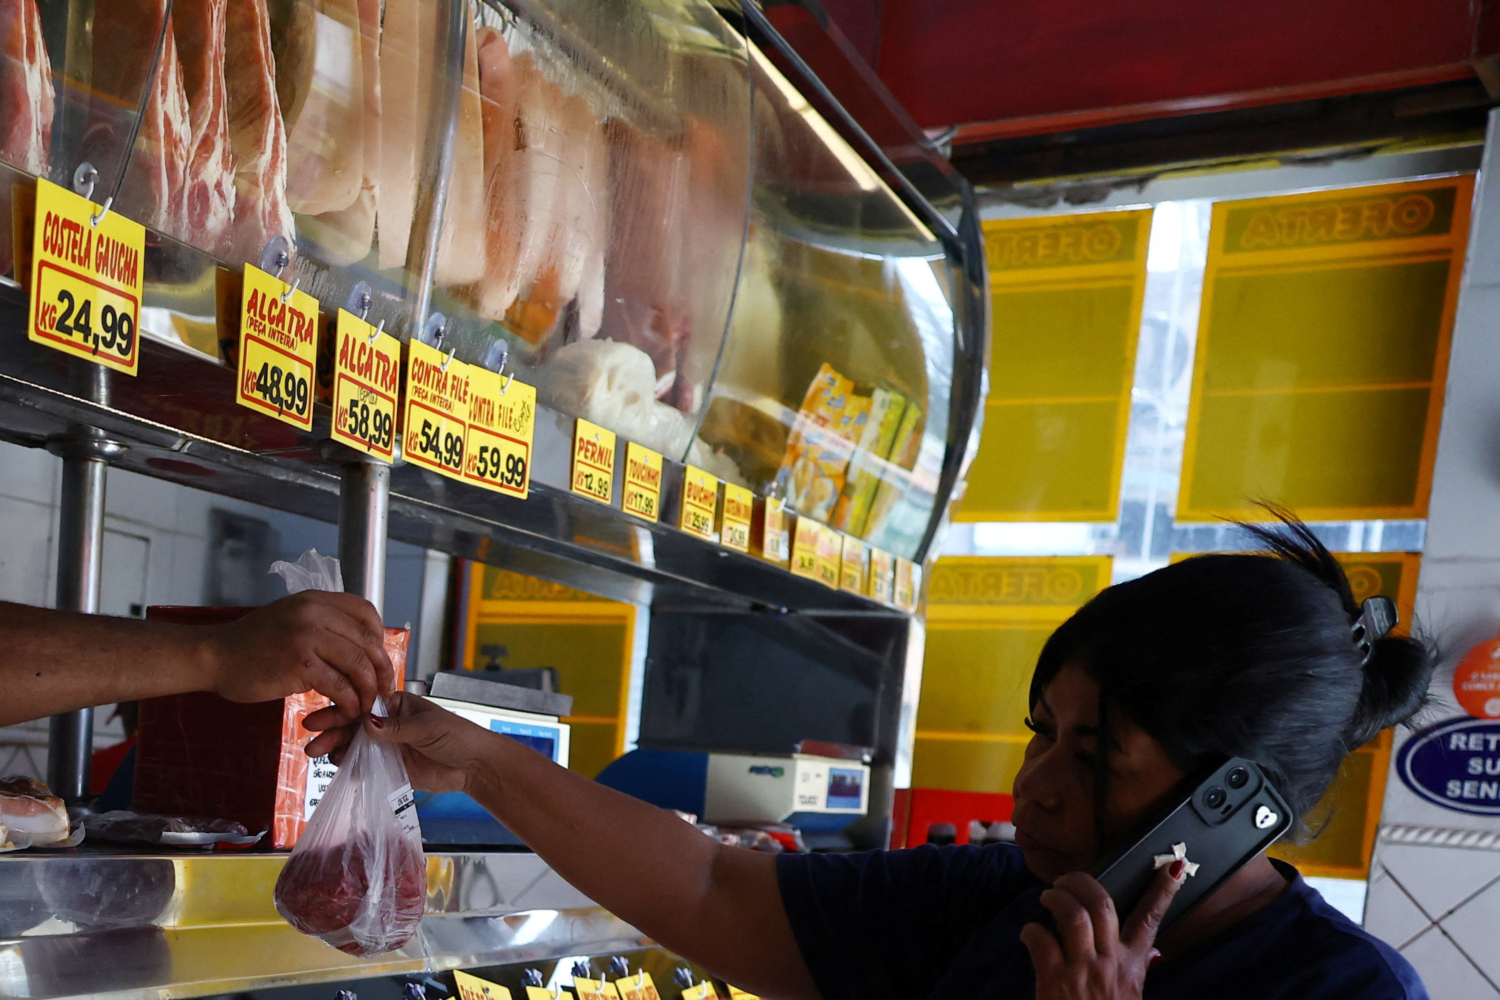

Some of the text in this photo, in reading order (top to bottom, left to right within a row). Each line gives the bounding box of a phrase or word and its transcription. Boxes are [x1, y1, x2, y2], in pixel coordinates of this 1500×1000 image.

[43, 211, 138, 289] COSTELA GAUCHA
[40, 289, 133, 356] KG 24,99
[246, 316, 298, 351] (PEÇA INTEIRA)
[247, 288, 314, 345] ALCATRA
[339, 333, 397, 394] ALCATRA
[411, 357, 469, 404] CONTRA FILÉ
[244, 362, 308, 417] KG 48,99
[430, 393, 454, 412] INTEIRA)
[469, 392, 495, 428] CONTRA
[338, 399, 392, 452] KG 58,99
[408, 419, 463, 468] KG 54,99
[466, 446, 526, 487] KG 59,99
[578, 437, 612, 469] PERNIL
